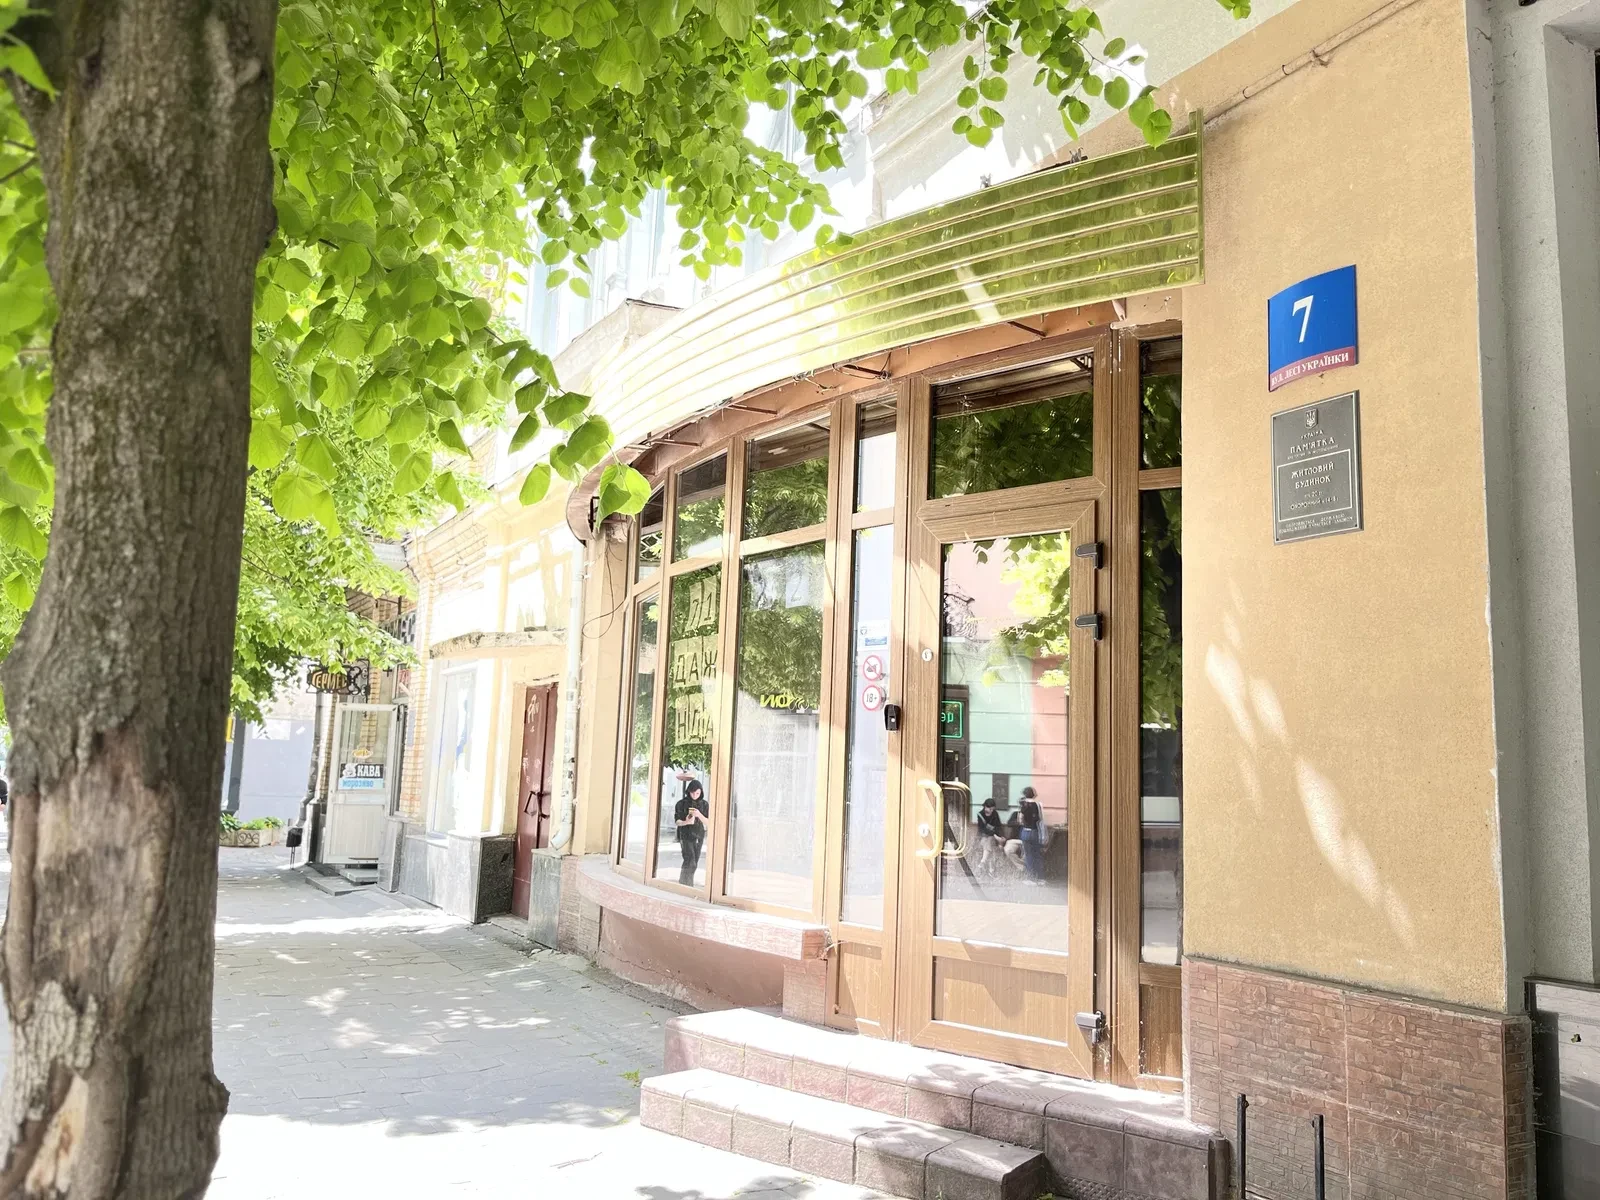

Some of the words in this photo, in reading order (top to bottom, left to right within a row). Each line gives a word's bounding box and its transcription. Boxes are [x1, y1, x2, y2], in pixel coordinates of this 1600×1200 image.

[1292, 295, 1314, 343] 7
[1301, 352, 1348, 372] УКРАЇНКИ
[1290, 436, 1335, 454] ПАМ'ЯТКА
[1291, 461, 1334, 479] ЖИТЛОВИЙ
[1295, 475, 1331, 489] БУДИНОК
[866, 693, 877, 703] 18+
[357, 764, 381, 777] КАВА
